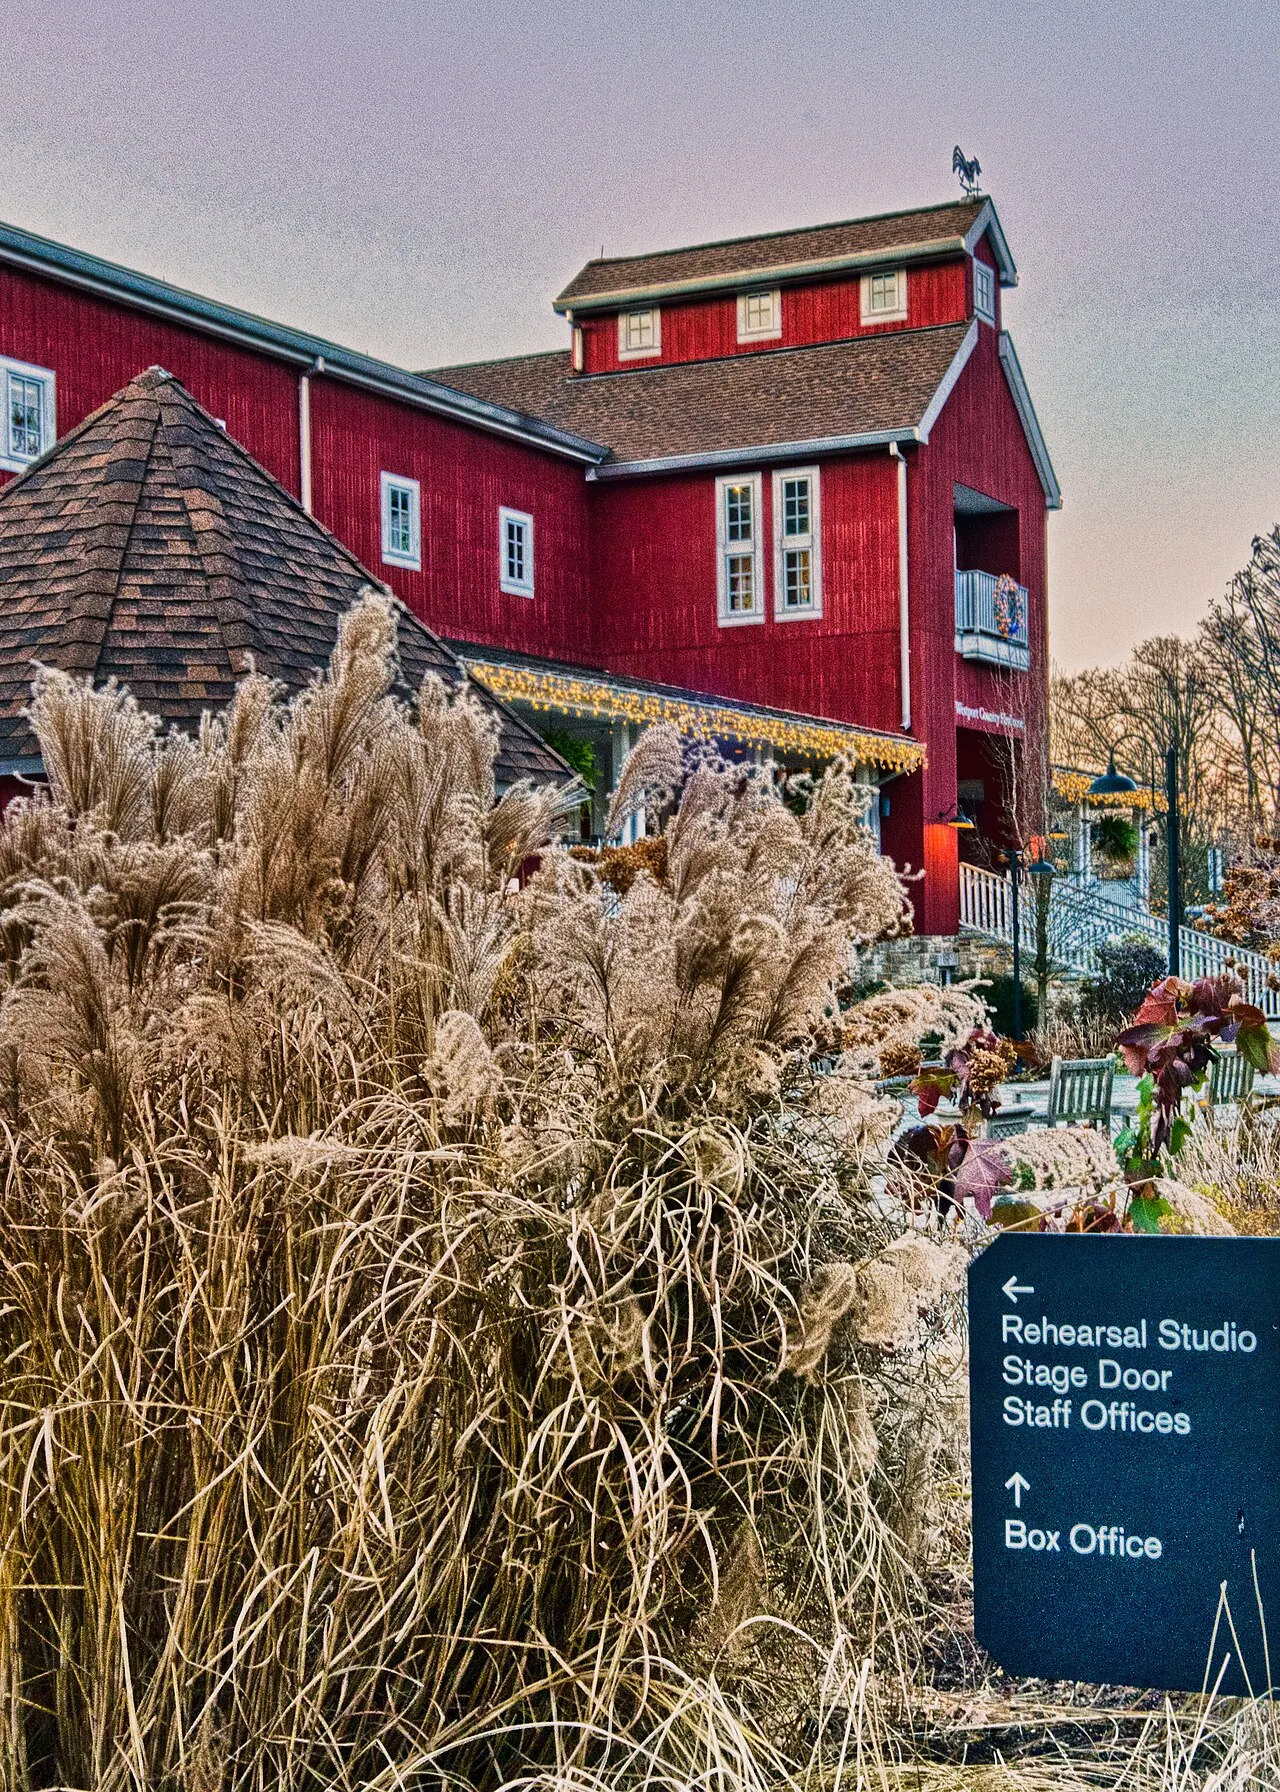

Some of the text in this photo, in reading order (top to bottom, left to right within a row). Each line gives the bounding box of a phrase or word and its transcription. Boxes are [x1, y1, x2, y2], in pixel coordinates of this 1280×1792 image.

[1002, 1315, 1257, 1353] Rehearsal Studio
[1002, 1355, 1172, 1395] Stage Door
[1003, 1397, 1191, 1435] Staff Offices
[1005, 1520, 1162, 1559] Box Office
